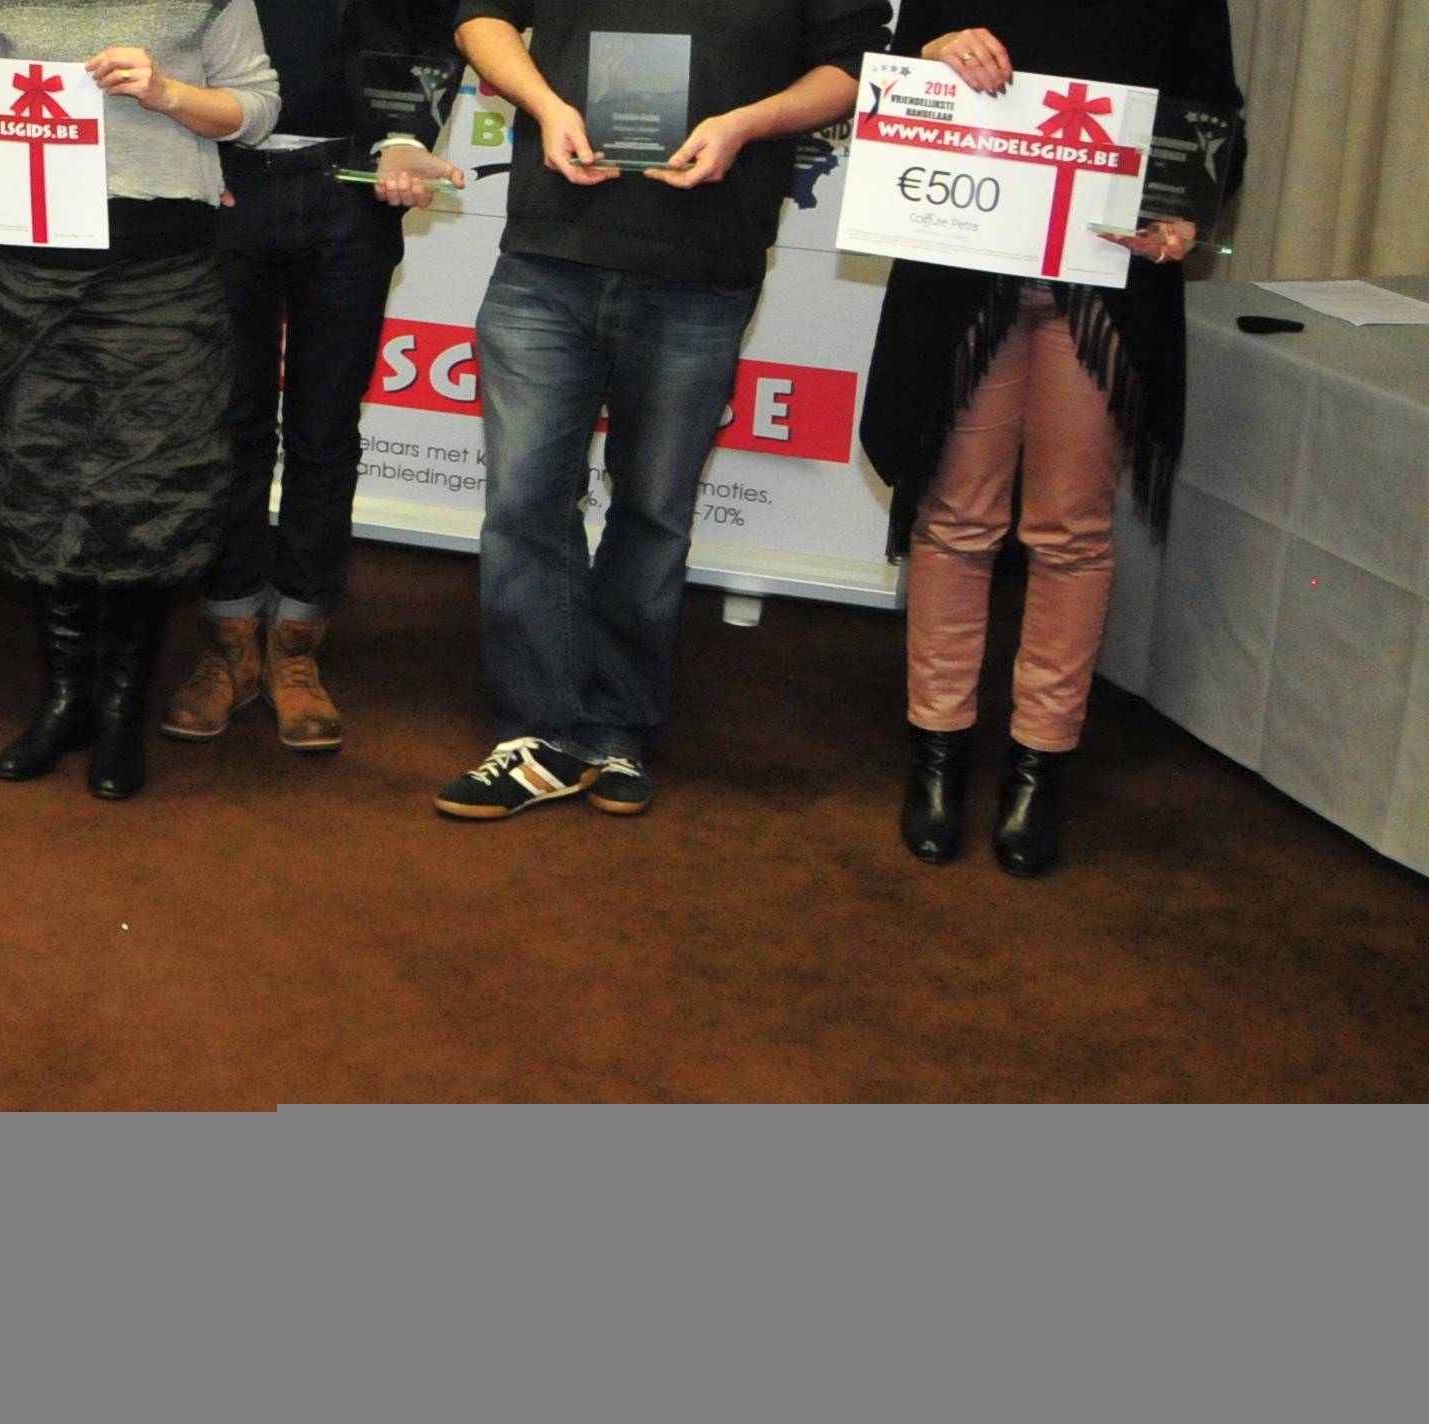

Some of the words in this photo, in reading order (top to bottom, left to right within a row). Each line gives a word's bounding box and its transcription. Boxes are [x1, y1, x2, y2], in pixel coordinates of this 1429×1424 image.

[925, 80, 957, 98] 2014
[878, 121, 1120, 168] WWW.HANDELSGIDS.BE
[897, 166, 1001, 213] €500
[427, 444, 469, 464] met
